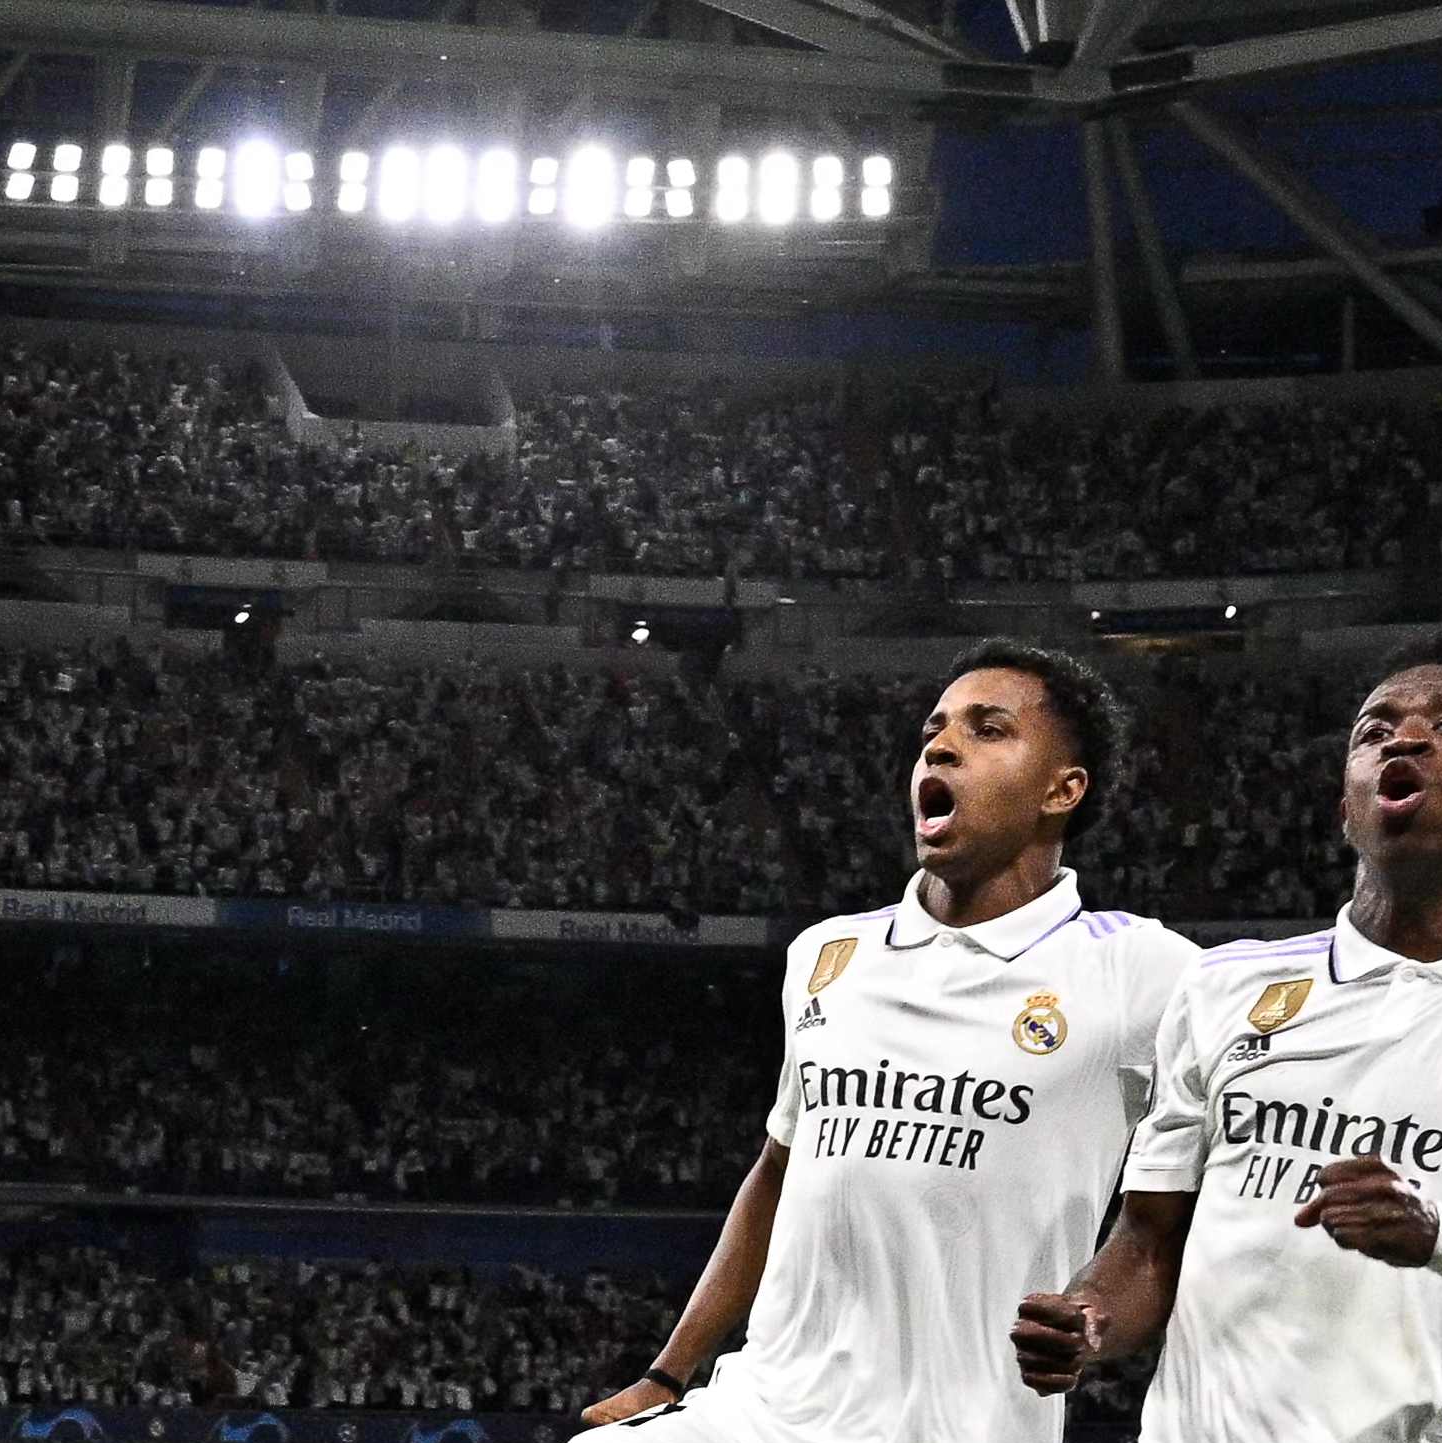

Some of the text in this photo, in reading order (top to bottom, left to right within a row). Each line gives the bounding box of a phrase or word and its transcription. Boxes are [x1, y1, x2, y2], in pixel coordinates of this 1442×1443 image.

[287, 905, 424, 932] Real Madrid
[799, 1059, 1034, 1125] Emirates
[815, 1117, 986, 1171] FLY BETTER
[1239, 1155, 1294, 1200] FLY
